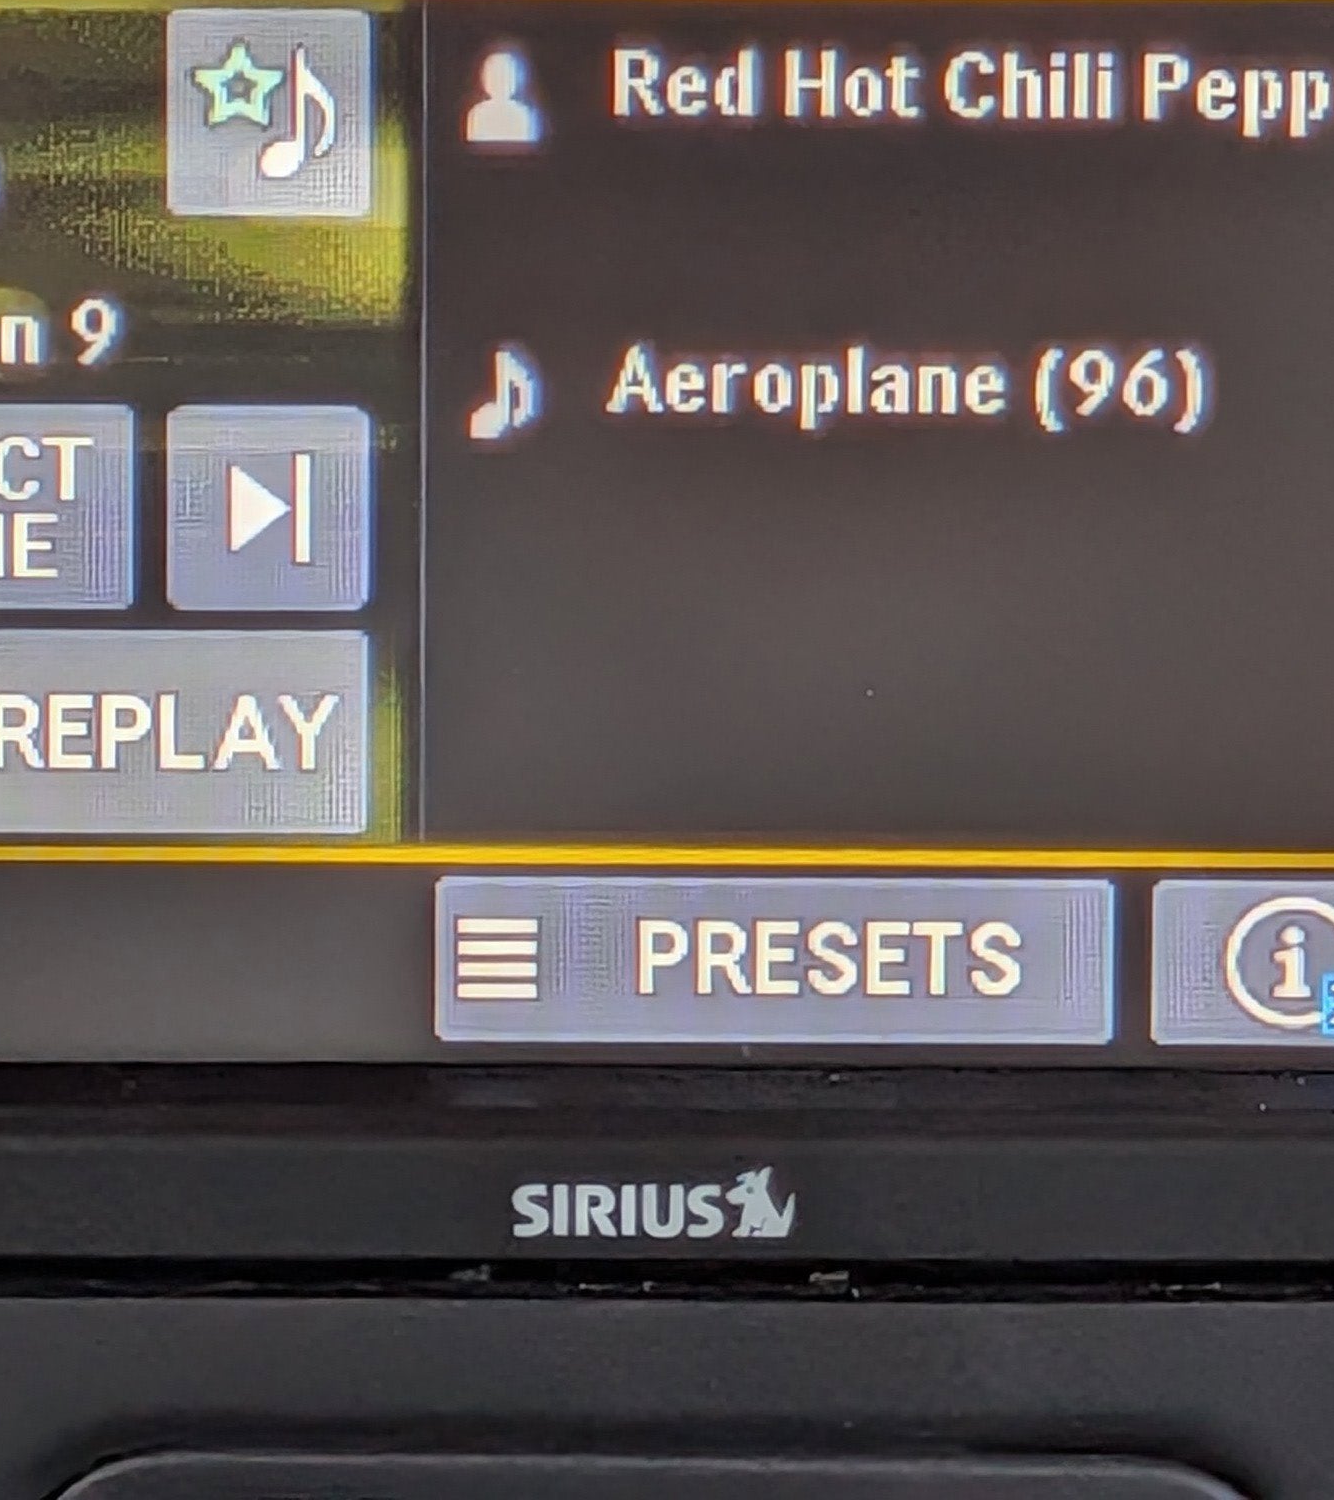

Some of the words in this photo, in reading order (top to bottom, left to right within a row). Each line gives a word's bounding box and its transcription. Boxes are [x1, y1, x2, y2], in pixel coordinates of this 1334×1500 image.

[611, 47, 759, 120] Red
[783, 47, 921, 121] Hot
[944, 50, 1116, 121] Chili
[71, 299, 119, 366] 9
[605, 342, 1007, 431] Aeroplane
[1035, 347, 1205, 434] (96)
[635, 917, 1022, 997] PRESETS
[511, 1181, 725, 1239] SIRIUS
